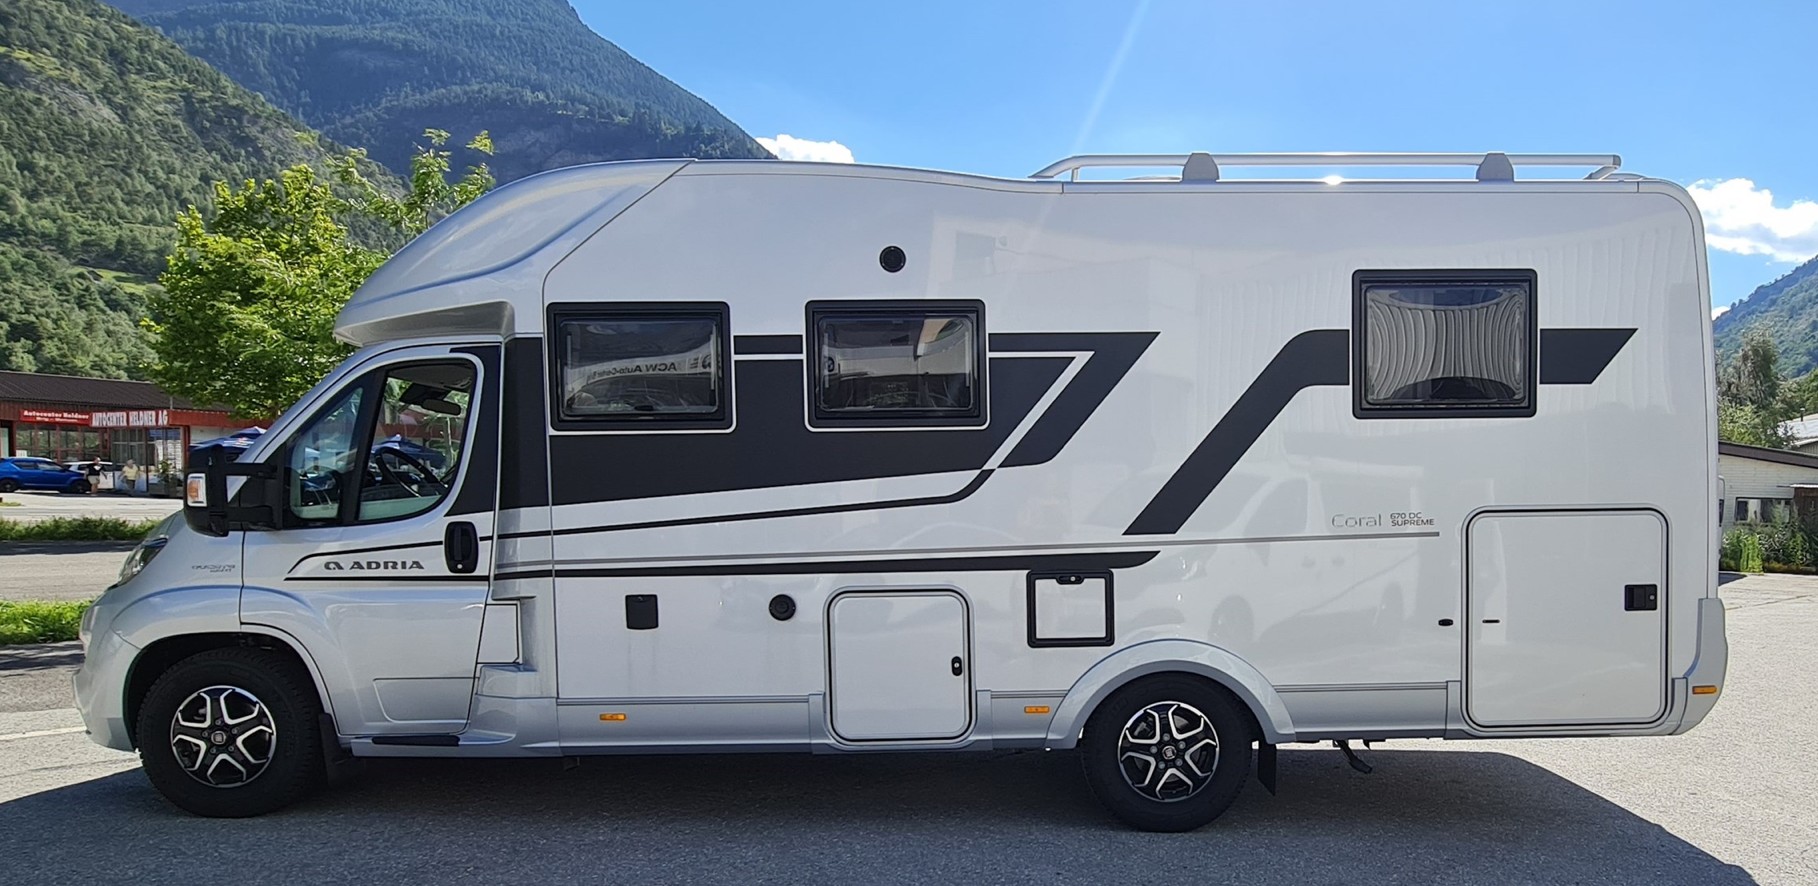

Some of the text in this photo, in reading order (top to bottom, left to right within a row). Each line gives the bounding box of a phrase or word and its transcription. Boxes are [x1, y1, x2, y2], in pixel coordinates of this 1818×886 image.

[92, 412, 127, 427] AUTOCENTER
[157, 410, 168, 425] AG
[1331, 513, 1382, 527] Coral
[1390, 511, 1422, 520] 670 DC
[349, 560, 425, 570] ADRIA
